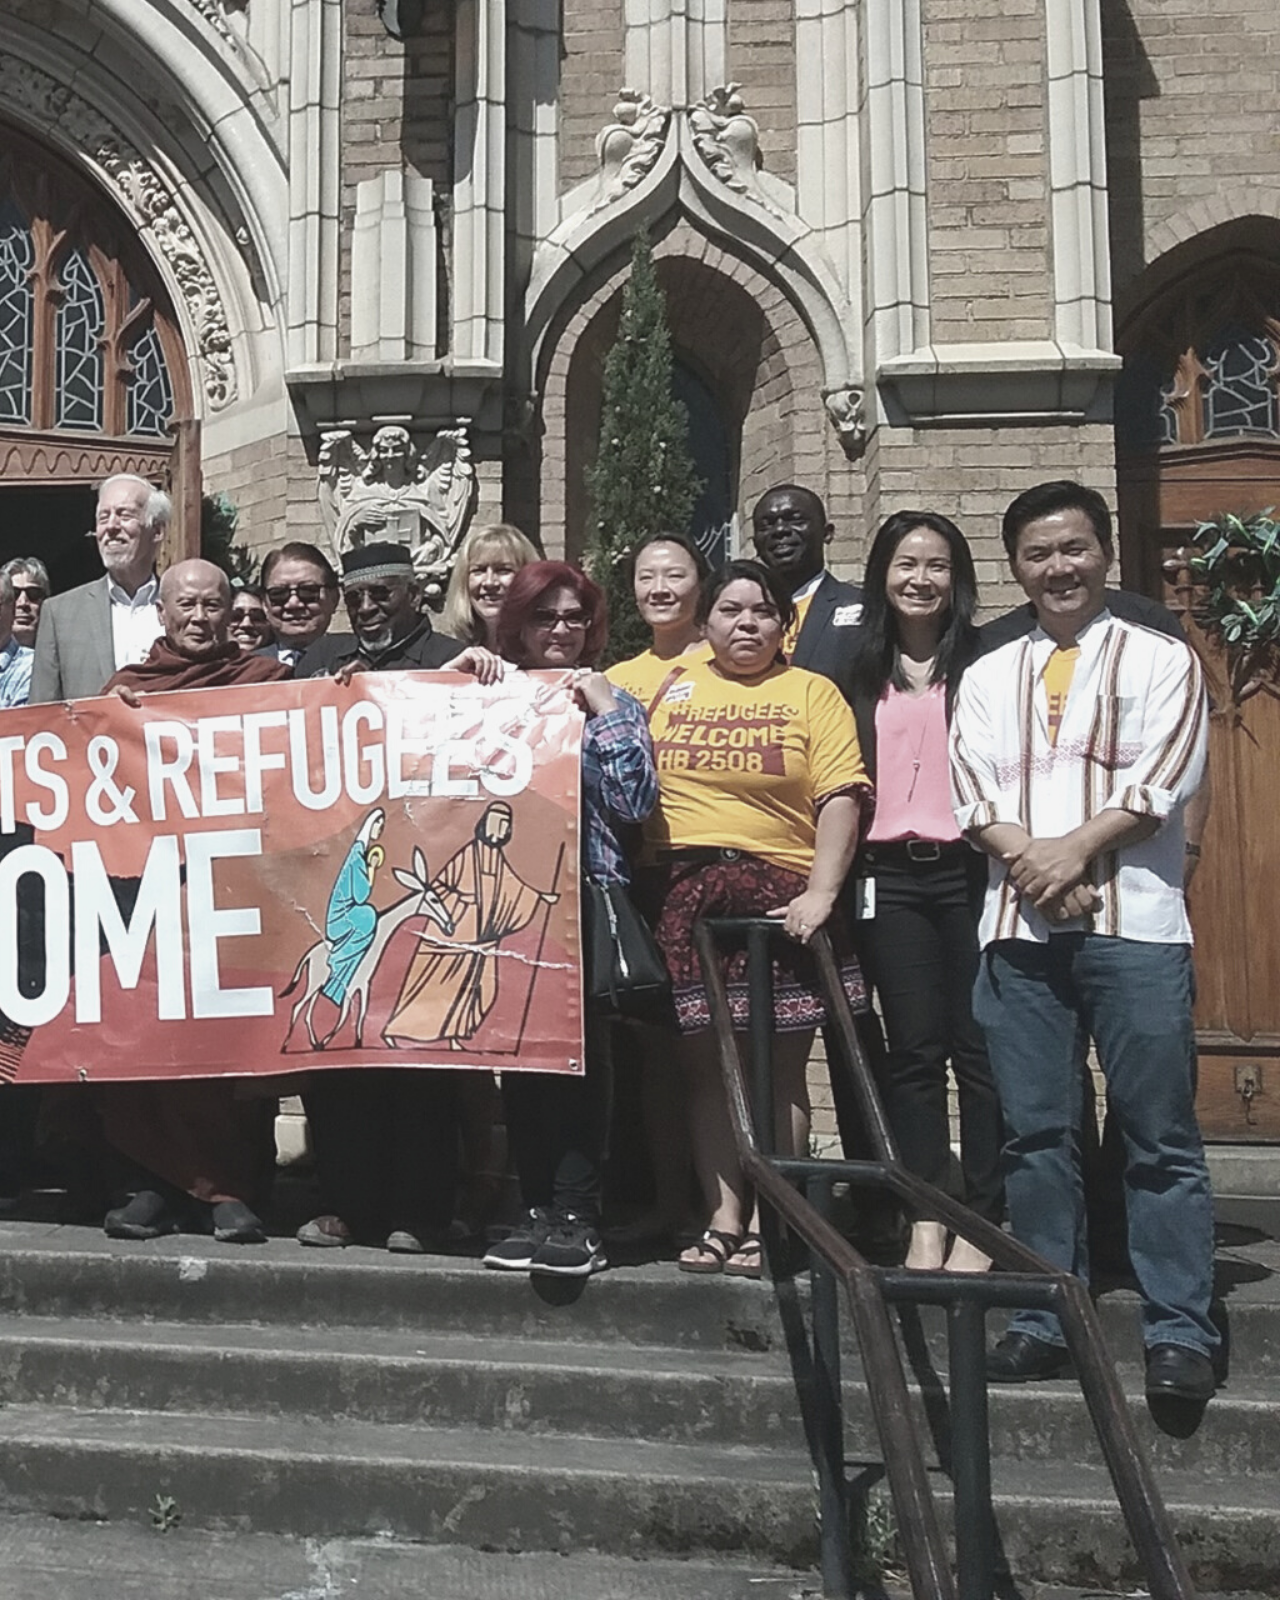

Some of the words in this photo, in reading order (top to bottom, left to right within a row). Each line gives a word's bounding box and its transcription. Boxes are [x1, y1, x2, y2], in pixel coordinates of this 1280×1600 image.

[84, 735, 140, 826] &
[144, 700, 534, 821] REFUGEES
[658, 749, 690, 771] HB
[696, 749, 763, 773] 2508
